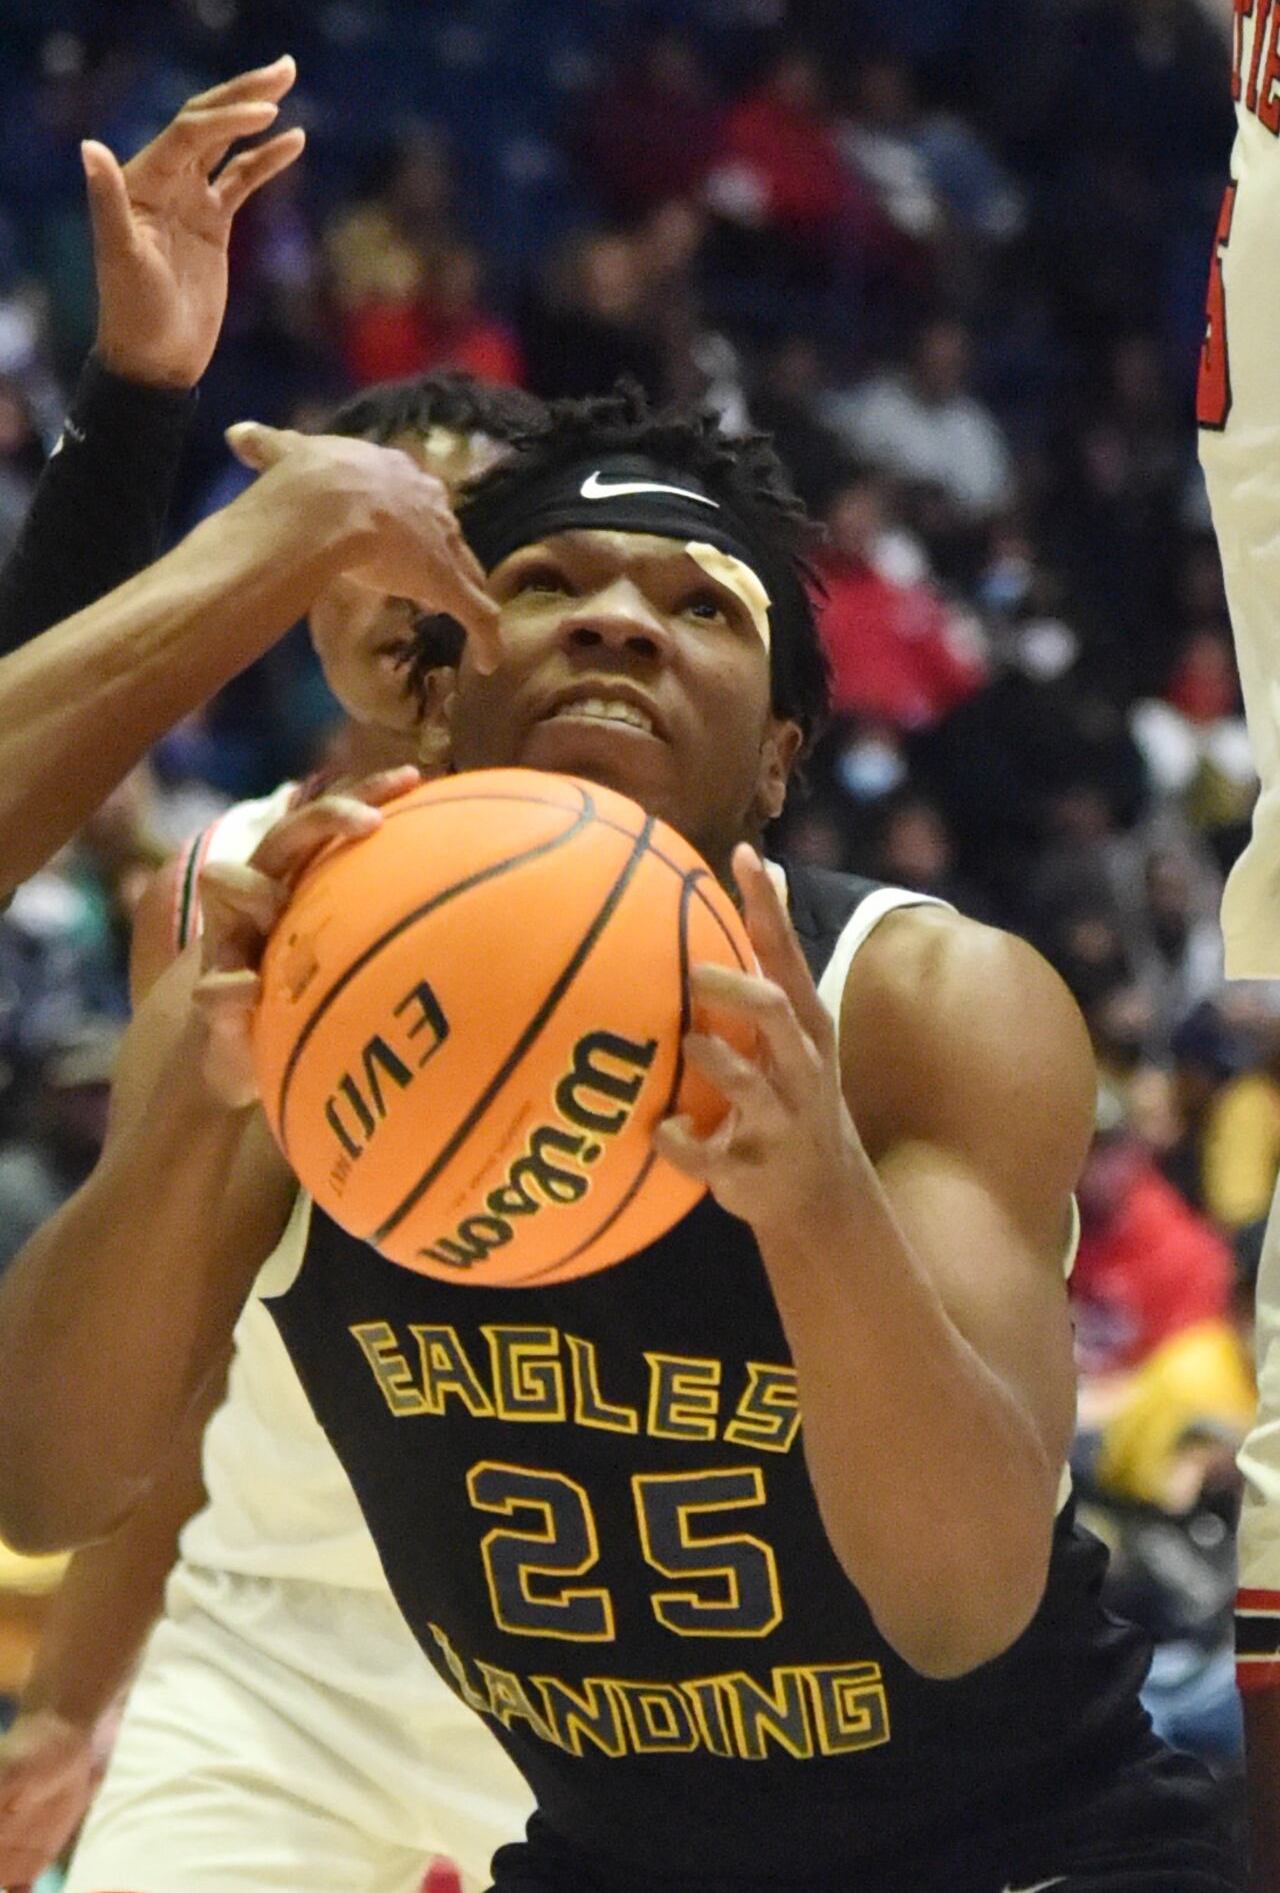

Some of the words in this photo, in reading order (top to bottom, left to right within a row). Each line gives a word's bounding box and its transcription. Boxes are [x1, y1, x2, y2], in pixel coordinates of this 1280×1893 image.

[416, 1028, 659, 1270] Wilson
[348, 1320, 803, 1454] EAGLES
[465, 1459, 785, 1643] 25
[427, 1621, 892, 1761] LANDING
